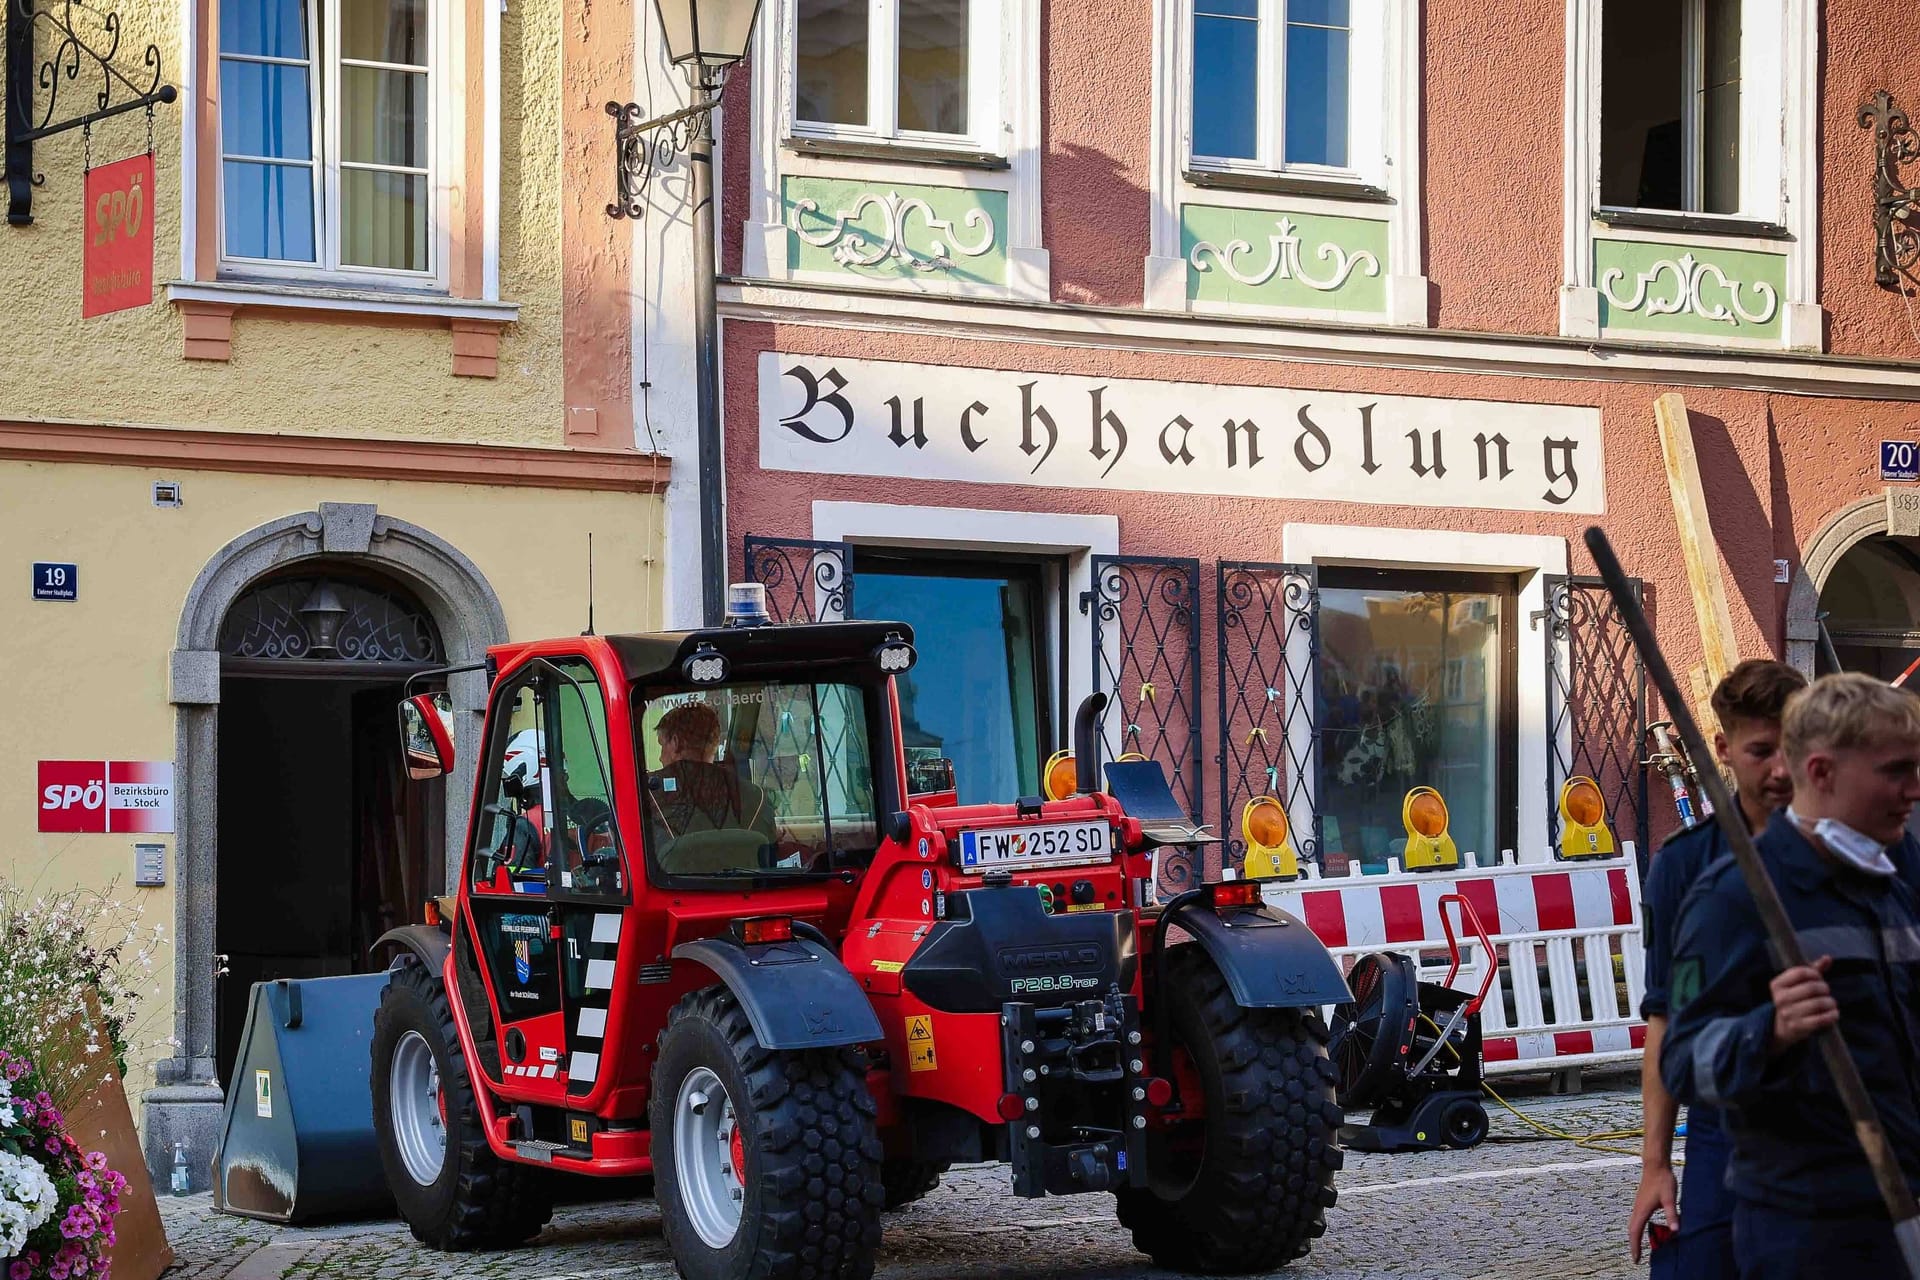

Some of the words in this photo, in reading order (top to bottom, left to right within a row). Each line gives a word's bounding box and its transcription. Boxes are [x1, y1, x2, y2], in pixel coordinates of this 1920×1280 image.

[94, 172, 144, 247] SPÖ
[778, 364, 1580, 506] Buchhandlung
[1887, 443, 1912, 468] 20
[1892, 494, 1919, 511] 1583
[45, 567, 66, 586] 19
[42, 779, 104, 810] SPÖ
[113, 786, 169, 796] Bezirksbüro
[123, 798, 133, 807] 1.
[134, 798, 160, 807] Stock
[979, 834, 1010, 860] FW
[1029, 830, 1071, 856] 252
[1075, 827, 1102, 853] SD
[967, 852, 974, 861] A
[568, 937, 581, 960] TL
[1002, 948, 1097, 969] MERLO
